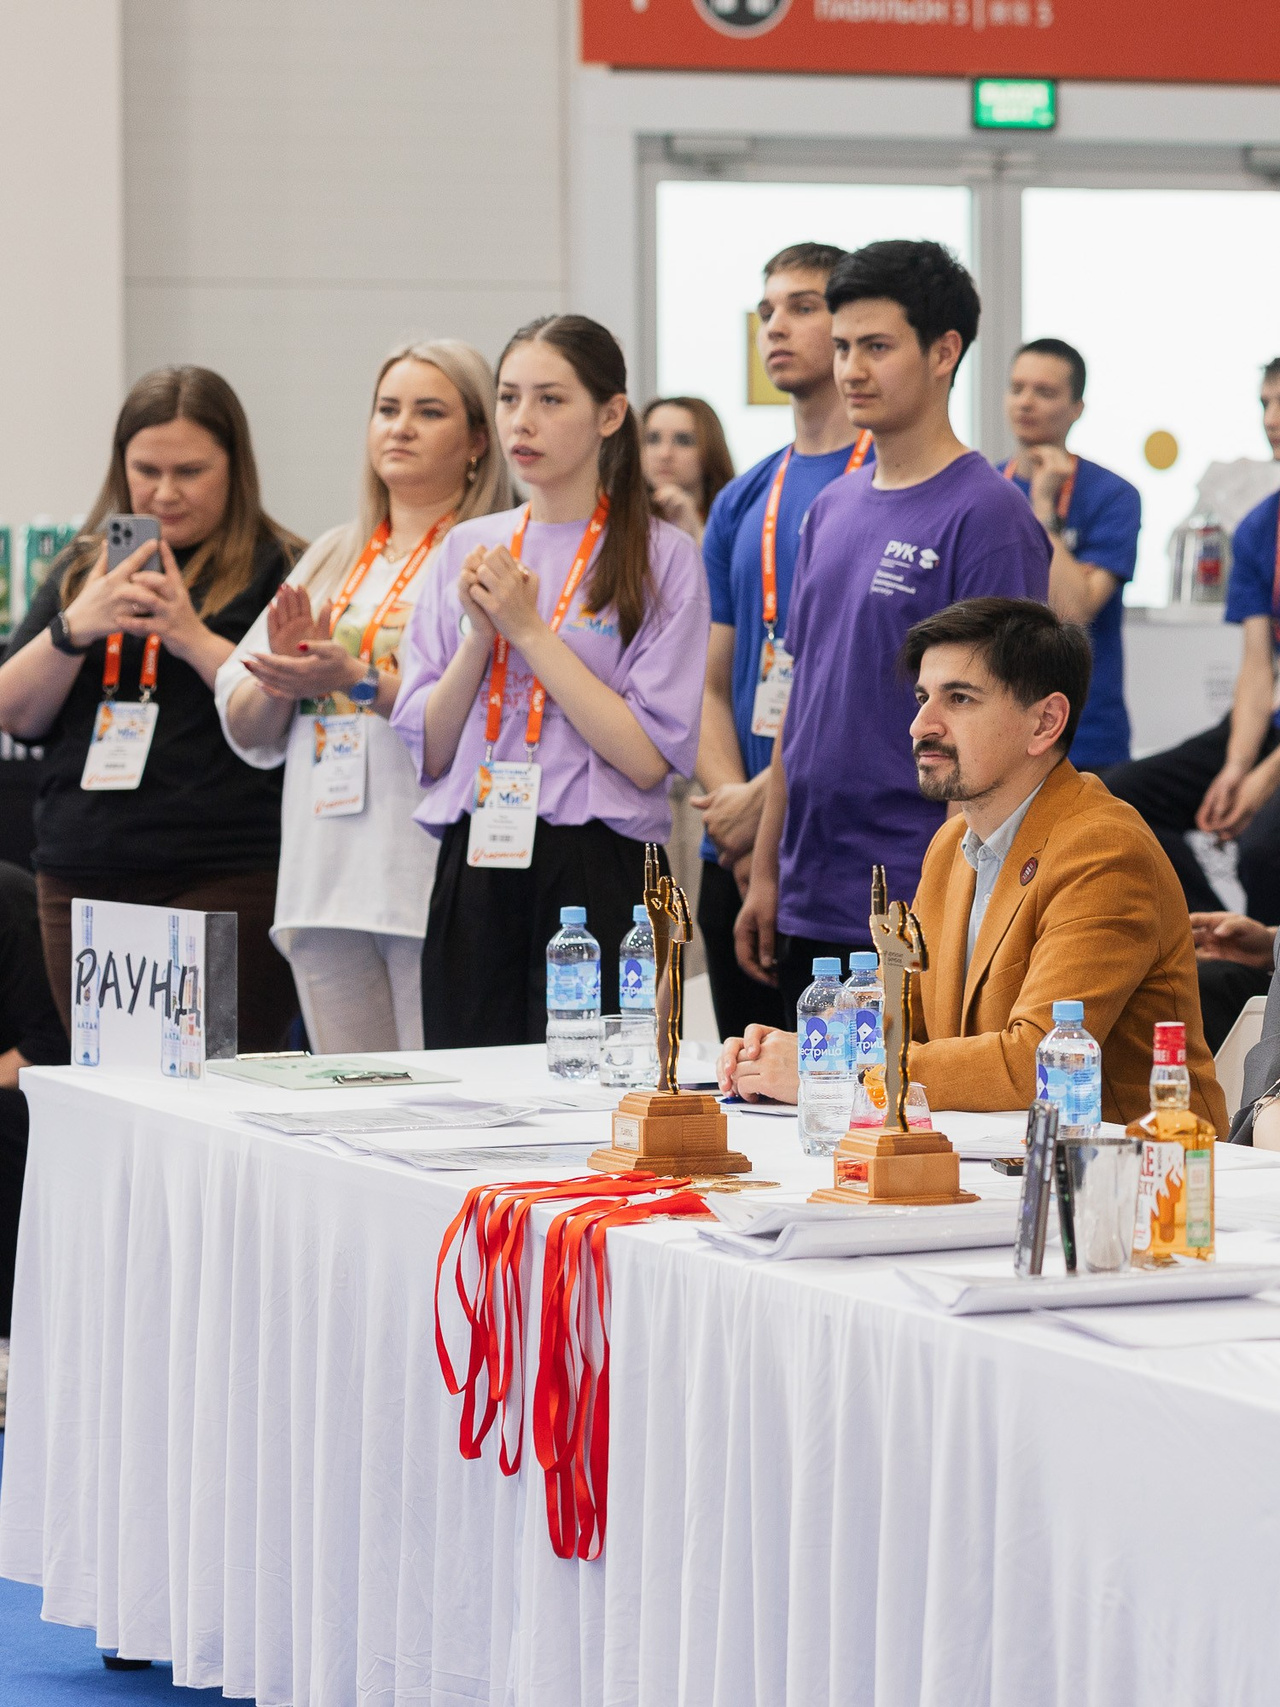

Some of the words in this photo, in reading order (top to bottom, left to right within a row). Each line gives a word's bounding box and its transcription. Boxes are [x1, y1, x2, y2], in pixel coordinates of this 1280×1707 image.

[884, 540, 918, 562] РУК
[75, 947, 201, 1030] РАУНД
[800, 1046, 843, 1058] естрица
